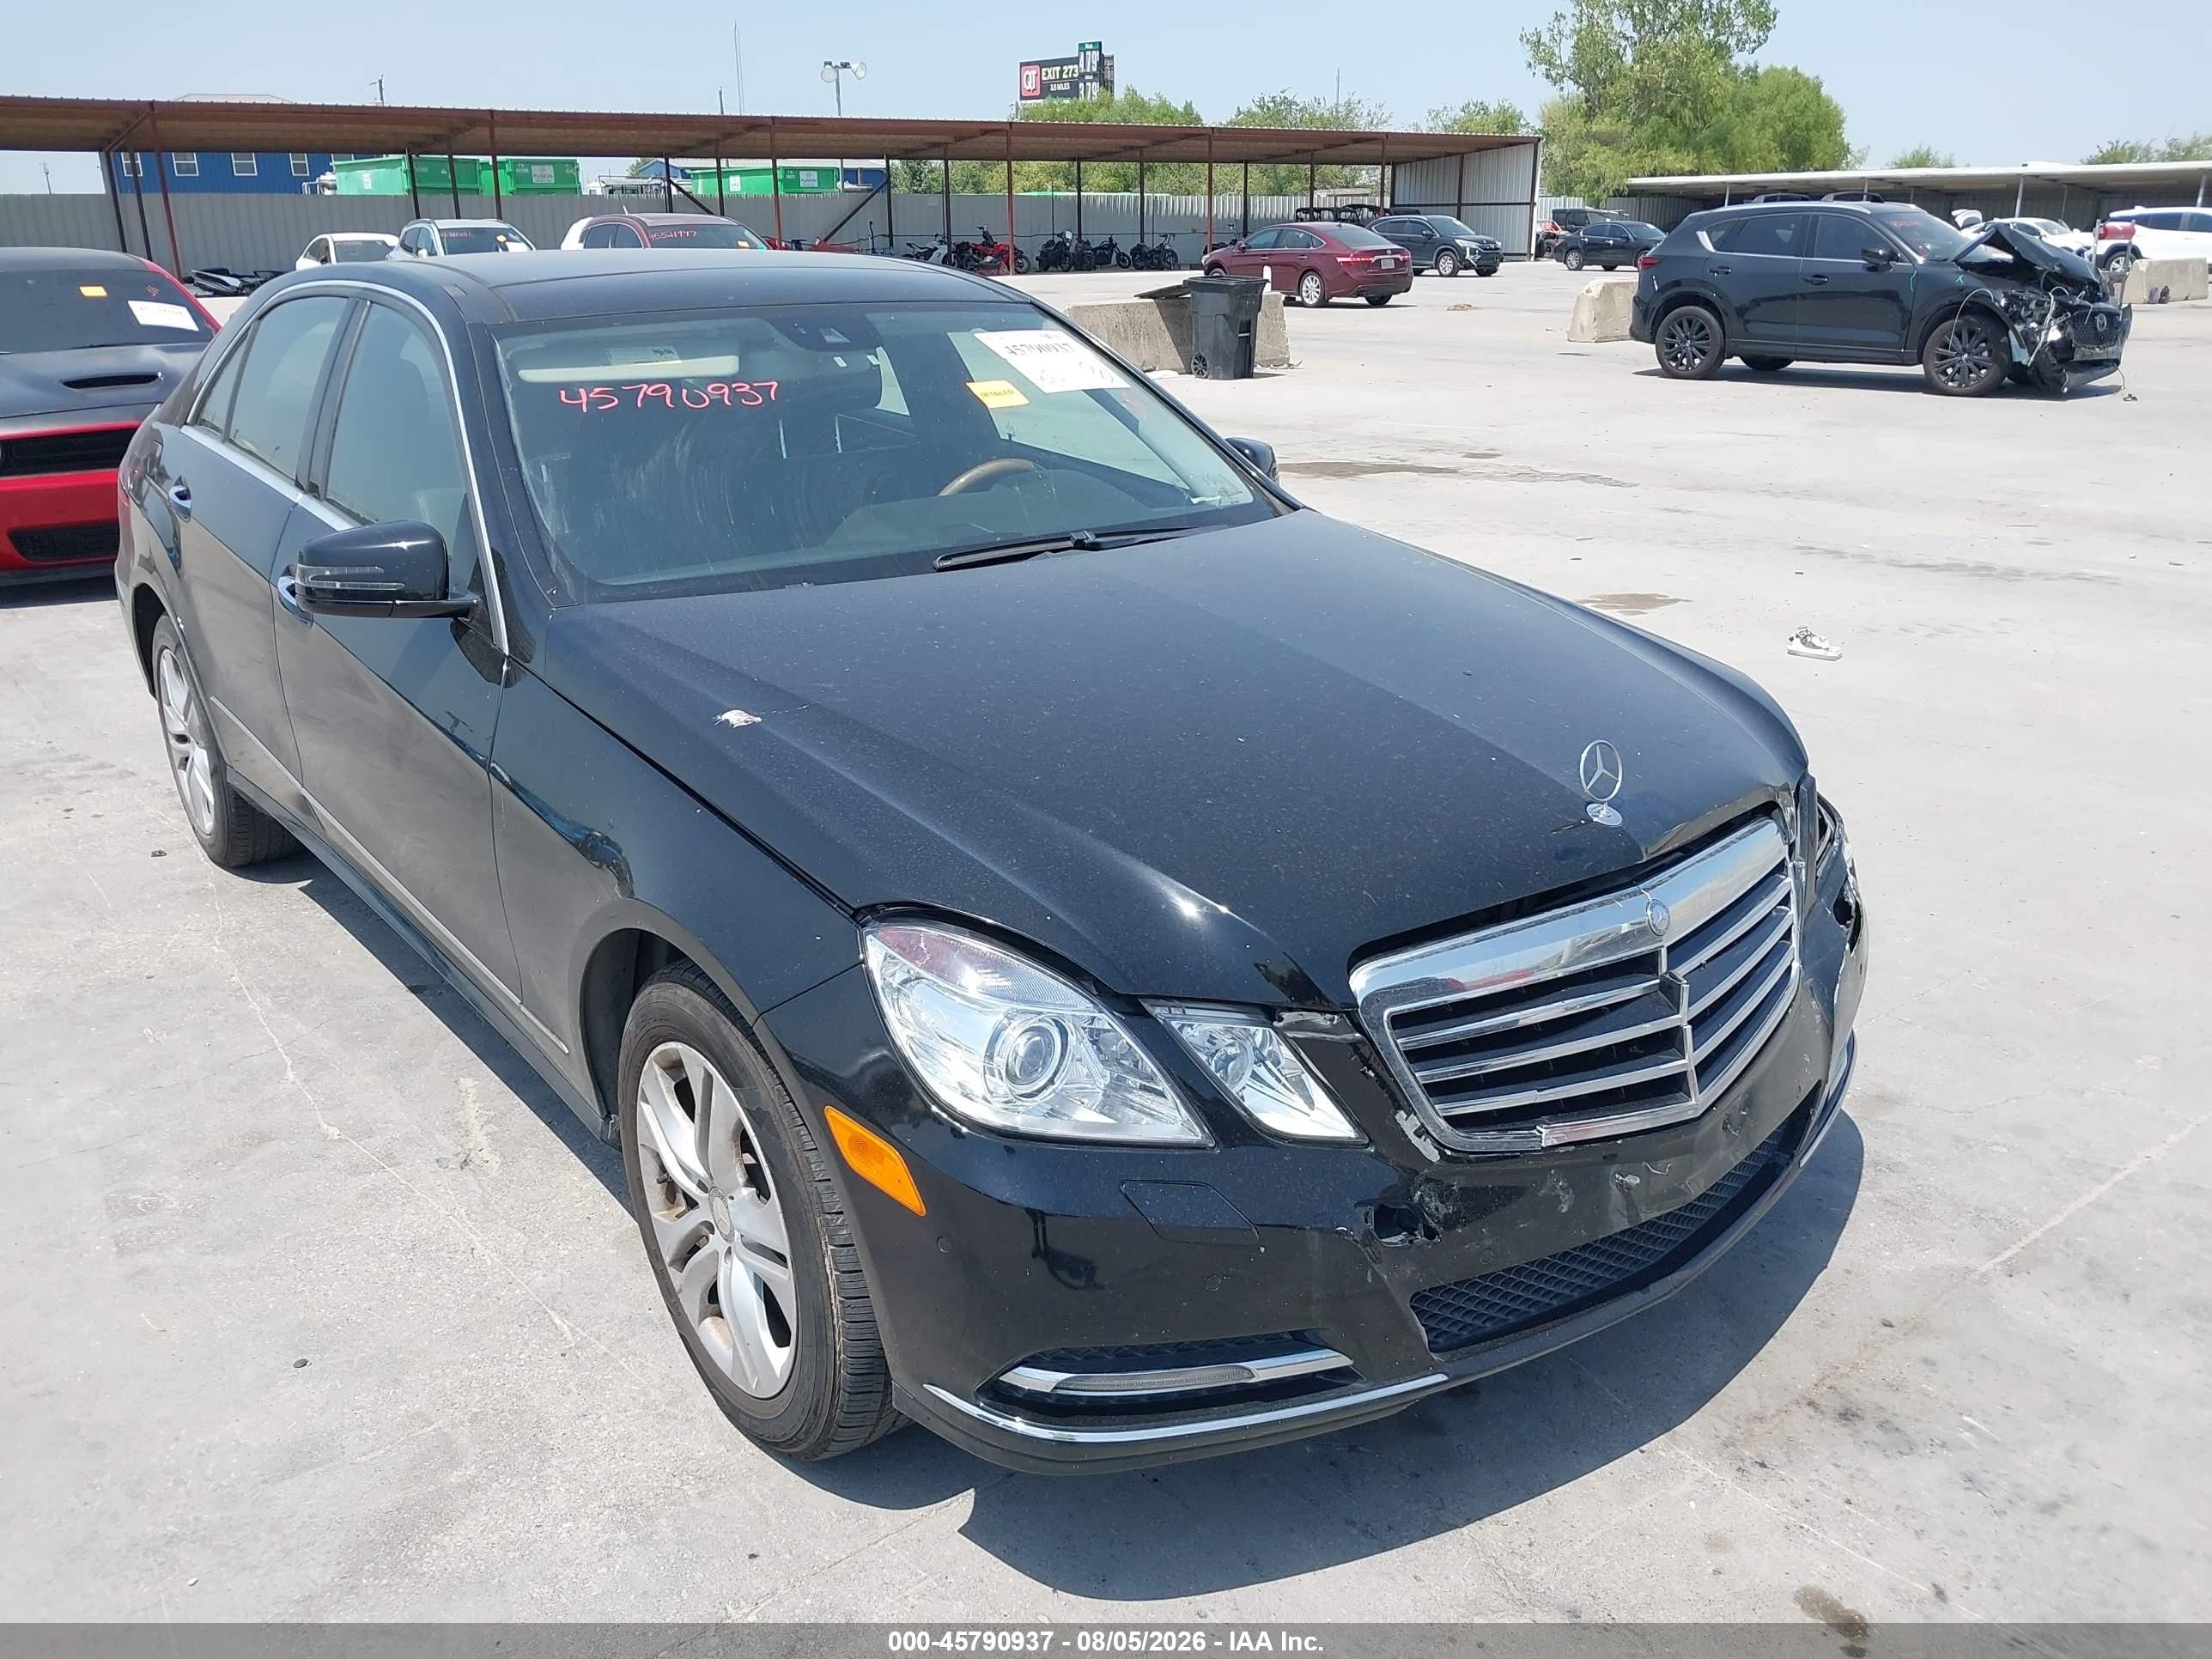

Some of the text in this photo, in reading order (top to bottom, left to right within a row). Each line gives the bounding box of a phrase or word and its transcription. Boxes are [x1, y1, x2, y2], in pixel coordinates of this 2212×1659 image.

[1023, 70, 1037, 92] QT
[1042, 66, 1060, 81] EXIT
[1062, 64, 1079, 79] 273
[560, 381, 778, 413] 45790937
